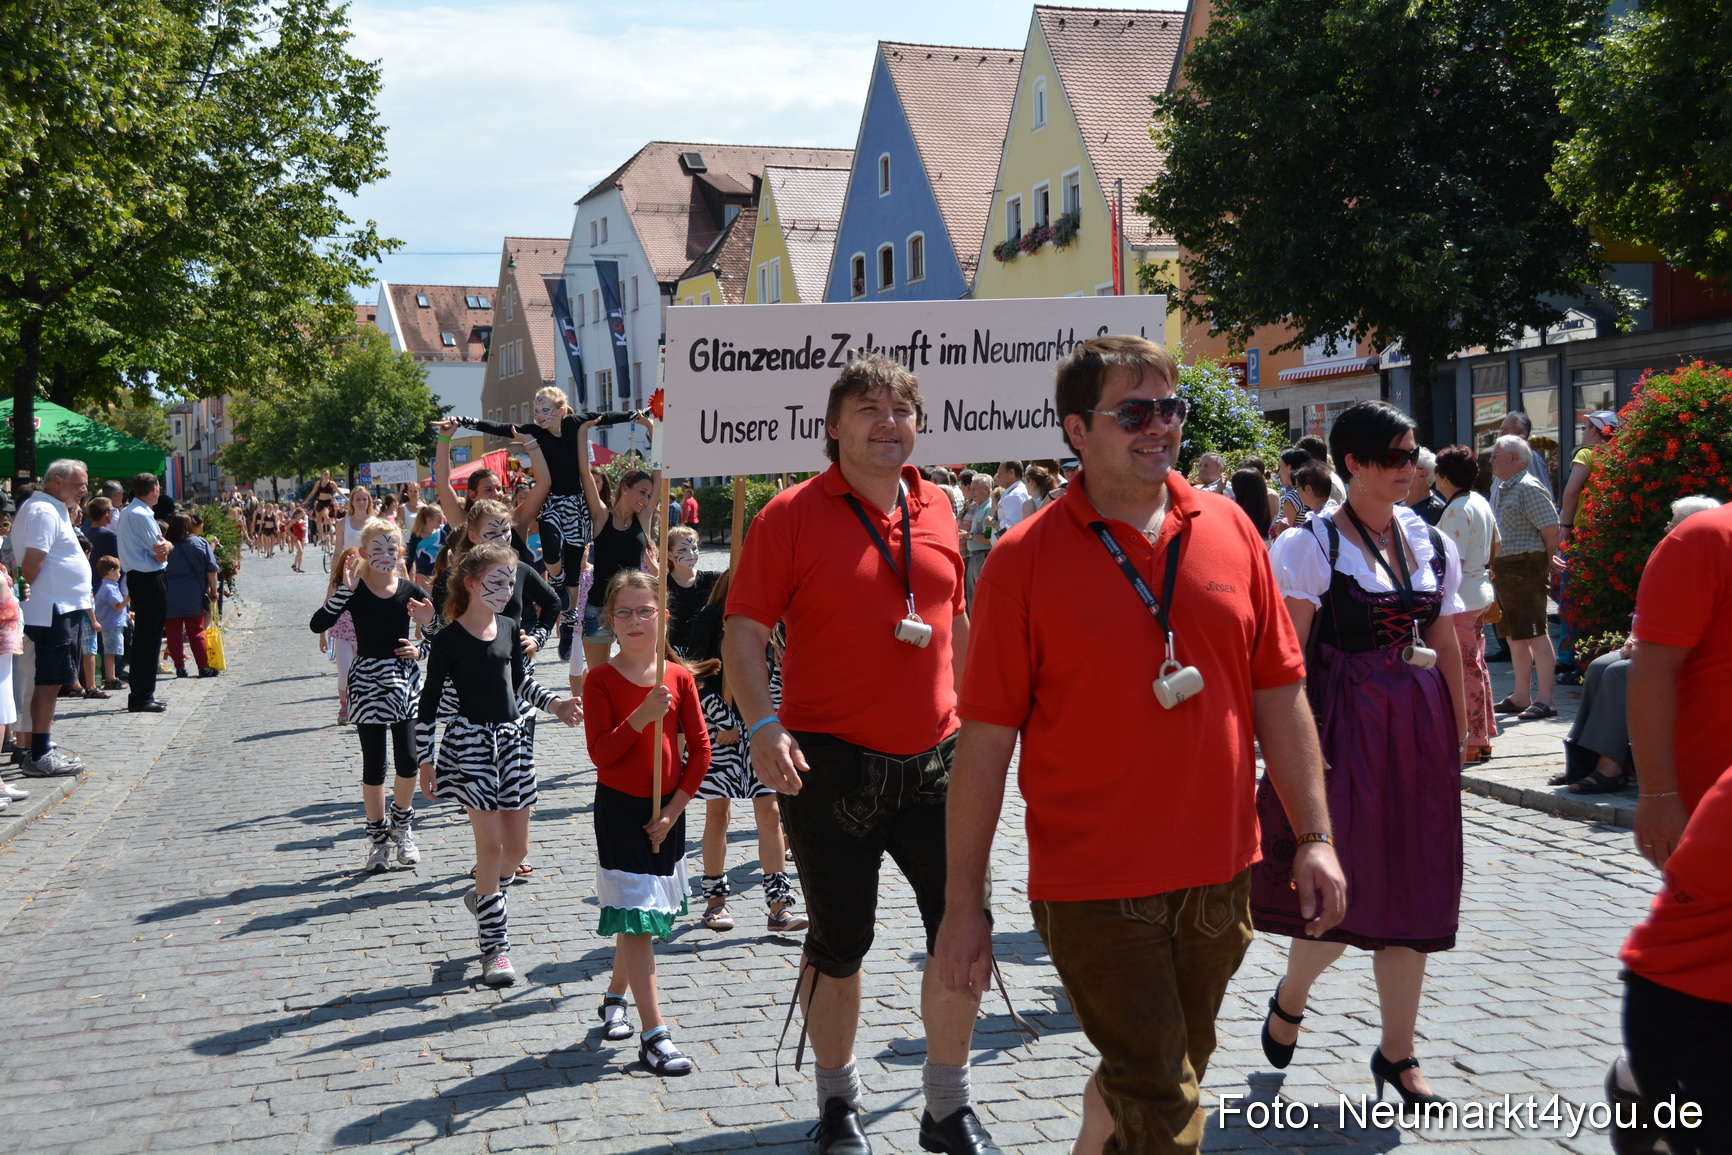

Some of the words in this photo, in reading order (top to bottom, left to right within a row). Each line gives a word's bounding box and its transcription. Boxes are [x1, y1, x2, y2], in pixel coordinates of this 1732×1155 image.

[689, 335, 826, 372] Glänzende
[940, 332, 966, 365] im
[1249, 353, 1257, 380] P
[700, 409, 779, 444] Unsere
[944, 398, 1062, 432] Nachwuch
